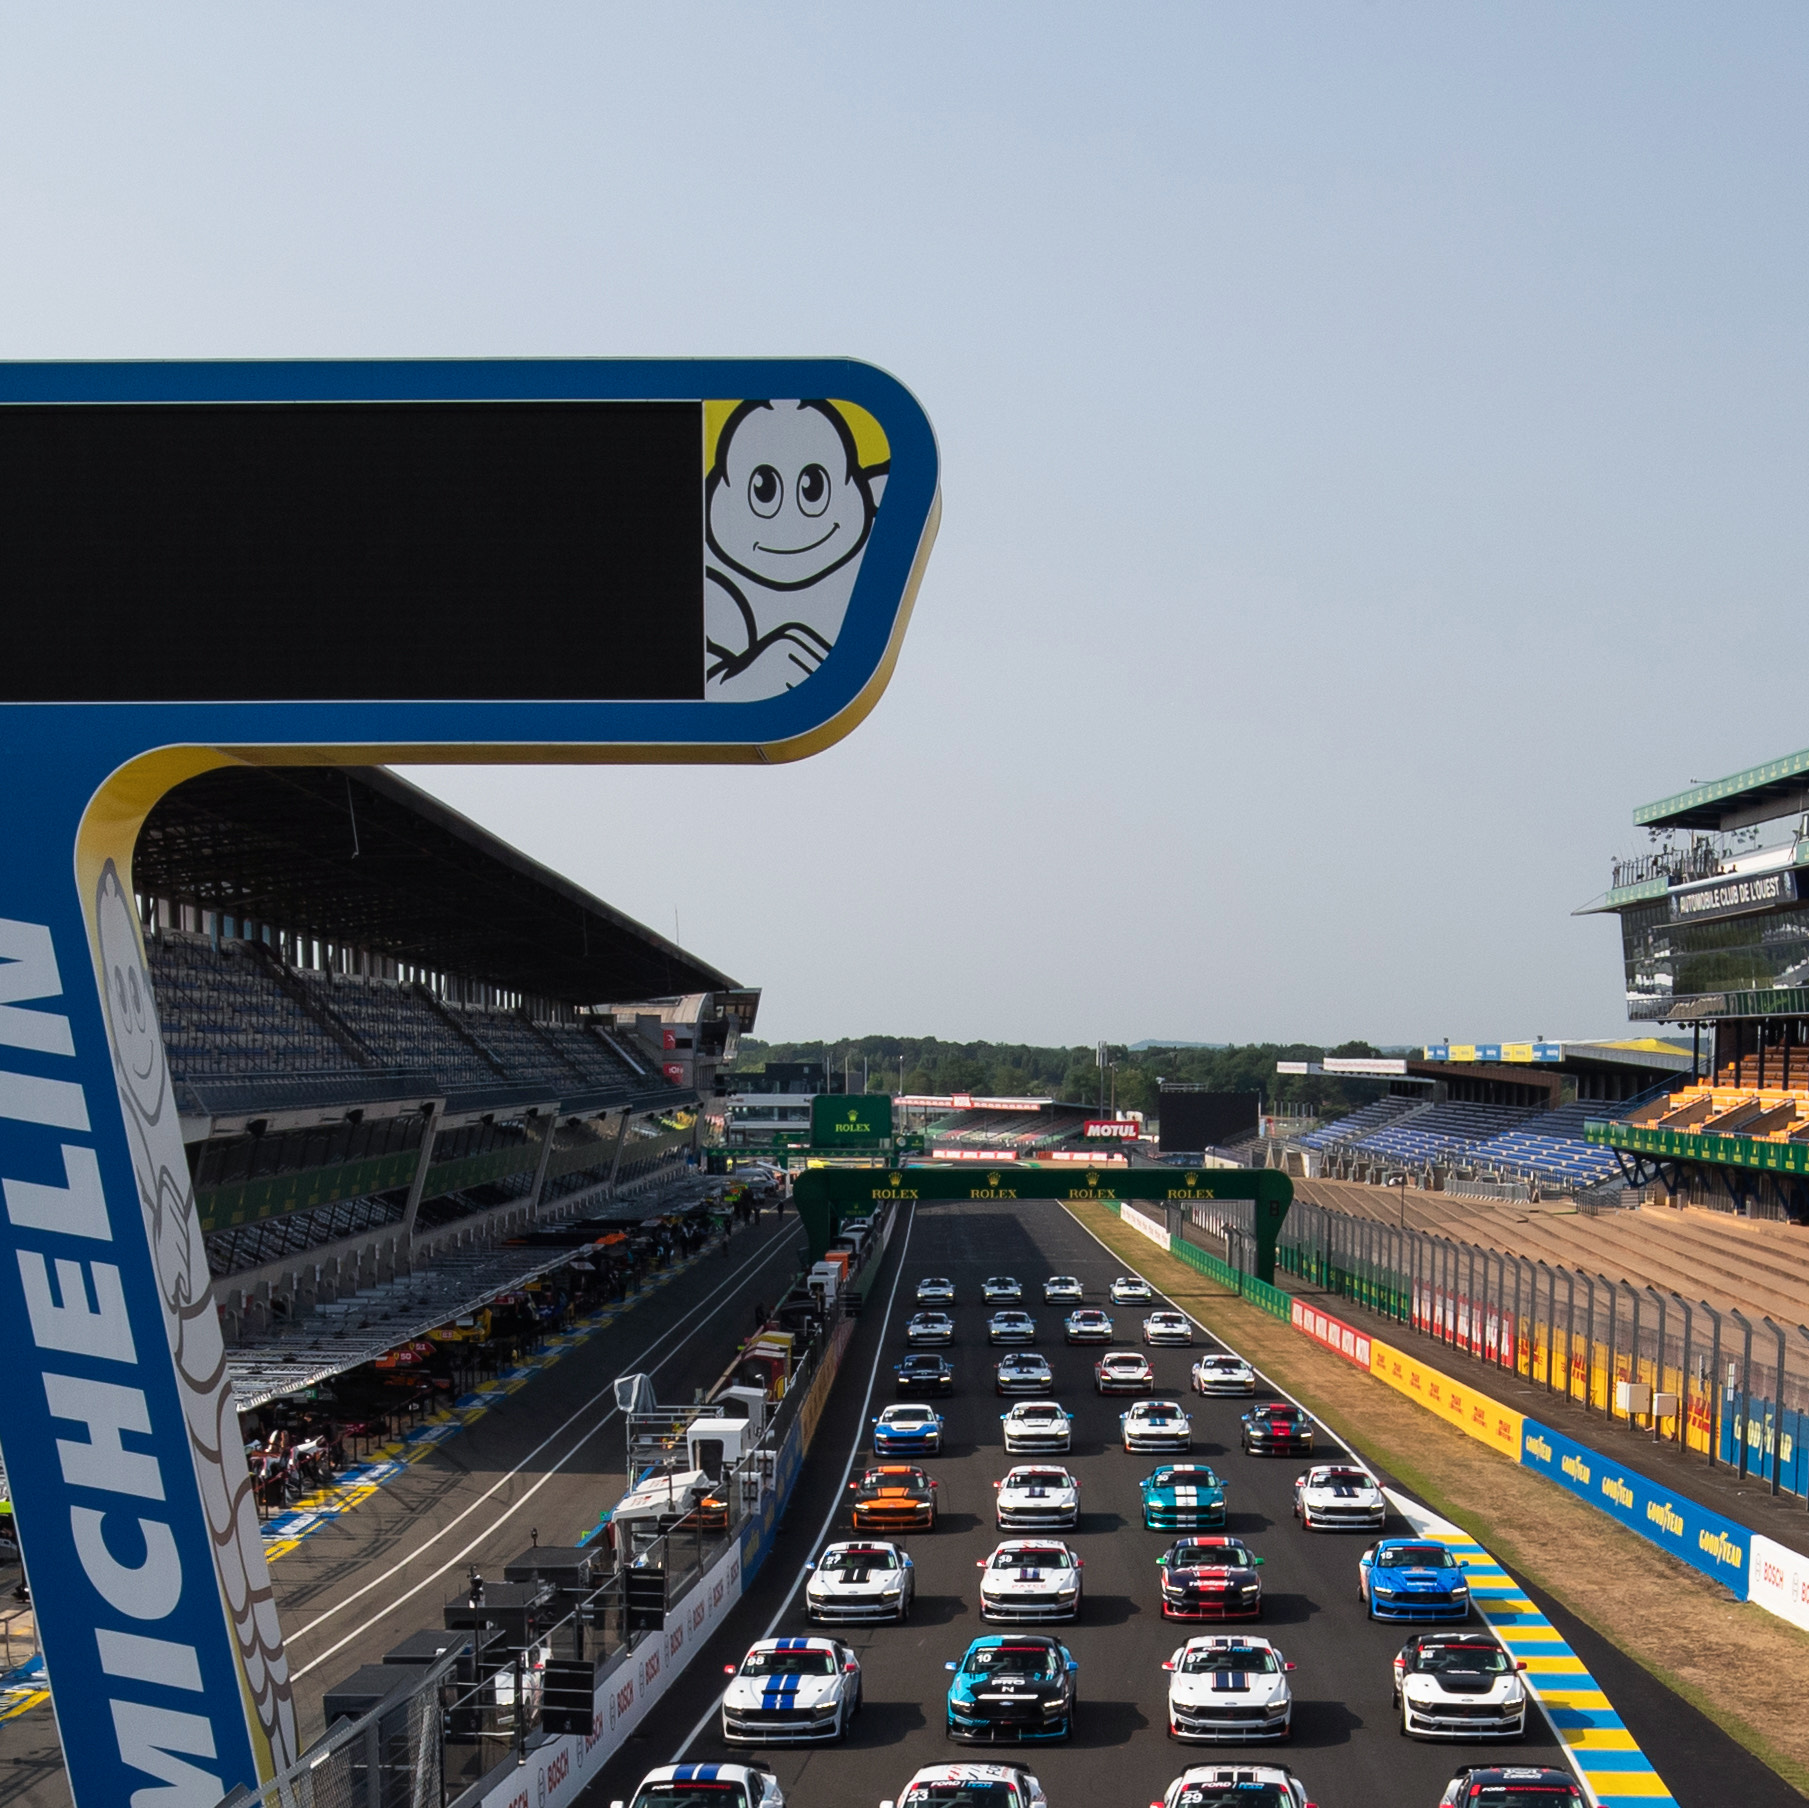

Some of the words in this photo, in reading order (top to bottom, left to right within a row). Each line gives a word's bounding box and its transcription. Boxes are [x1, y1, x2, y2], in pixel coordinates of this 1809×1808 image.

[1720, 885, 1738, 906] CLUB
[1739, 883, 1750, 902] DE
[1750, 876, 1779, 900] L'OUEST
[835, 1124, 870, 1132] ROLEX
[1087, 1125, 1137, 1137] MOTUL
[871, 1189, 918, 1200] ROLEX
[970, 1189, 1017, 1199] ROLEX
[1069, 1189, 1116, 1199] ROLEX
[1168, 1189, 1214, 1199] ROLEX
[1526, 1435, 1552, 1462] GOODYEAR
[1561, 1453, 1590, 1485] GOODYEAR
[1602, 1476, 1633, 1509] GOODYEAR
[1647, 1500, 1684, 1537] GOODYEAR
[1698, 1528, 1743, 1569] GOODYEAR
[1763, 1560, 1785, 1591] BOSCH
[692, 1603, 705, 1630] BOSCH
[670, 1624, 683, 1655] BOSCH
[975, 1653, 993, 1664] 10
[645, 1656, 660, 1689] BOSCH
[616, 1681, 634, 1717] BOSCH
[547, 1748, 569, 1793] BOSCH
[907, 1790, 934, 1803] 23
[929, 1780, 967, 1789] FORD
[1201, 1781, 1232, 1790] FORD
[1180, 1792, 1203, 1805] 29
